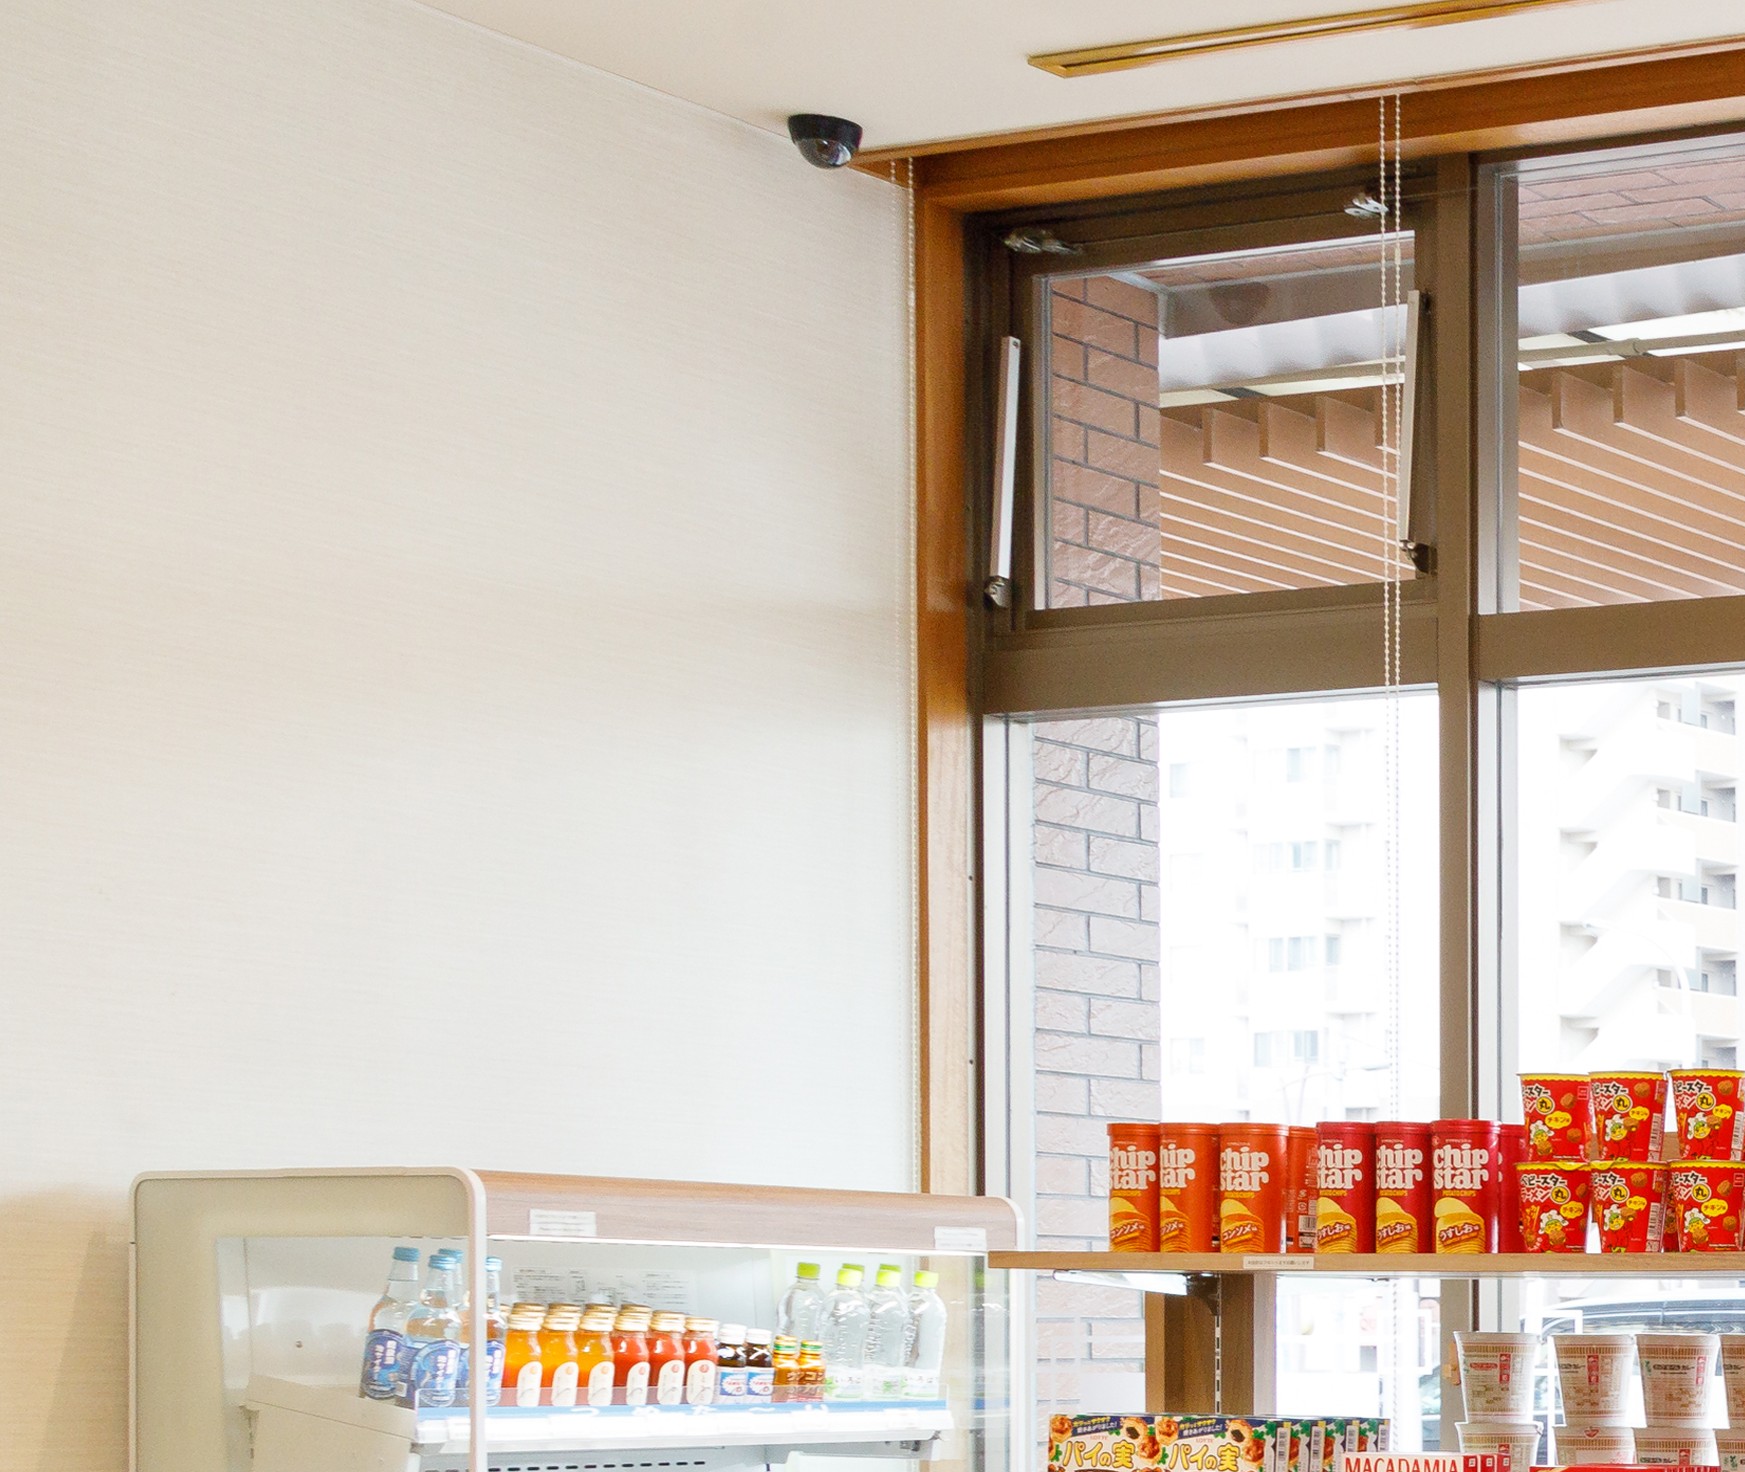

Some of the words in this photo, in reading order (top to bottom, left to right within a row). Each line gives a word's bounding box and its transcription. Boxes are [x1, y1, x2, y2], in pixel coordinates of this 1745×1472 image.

[1062, 1439, 1135, 1470] パイの実
[1168, 1443, 1240, 1472] パイの実
